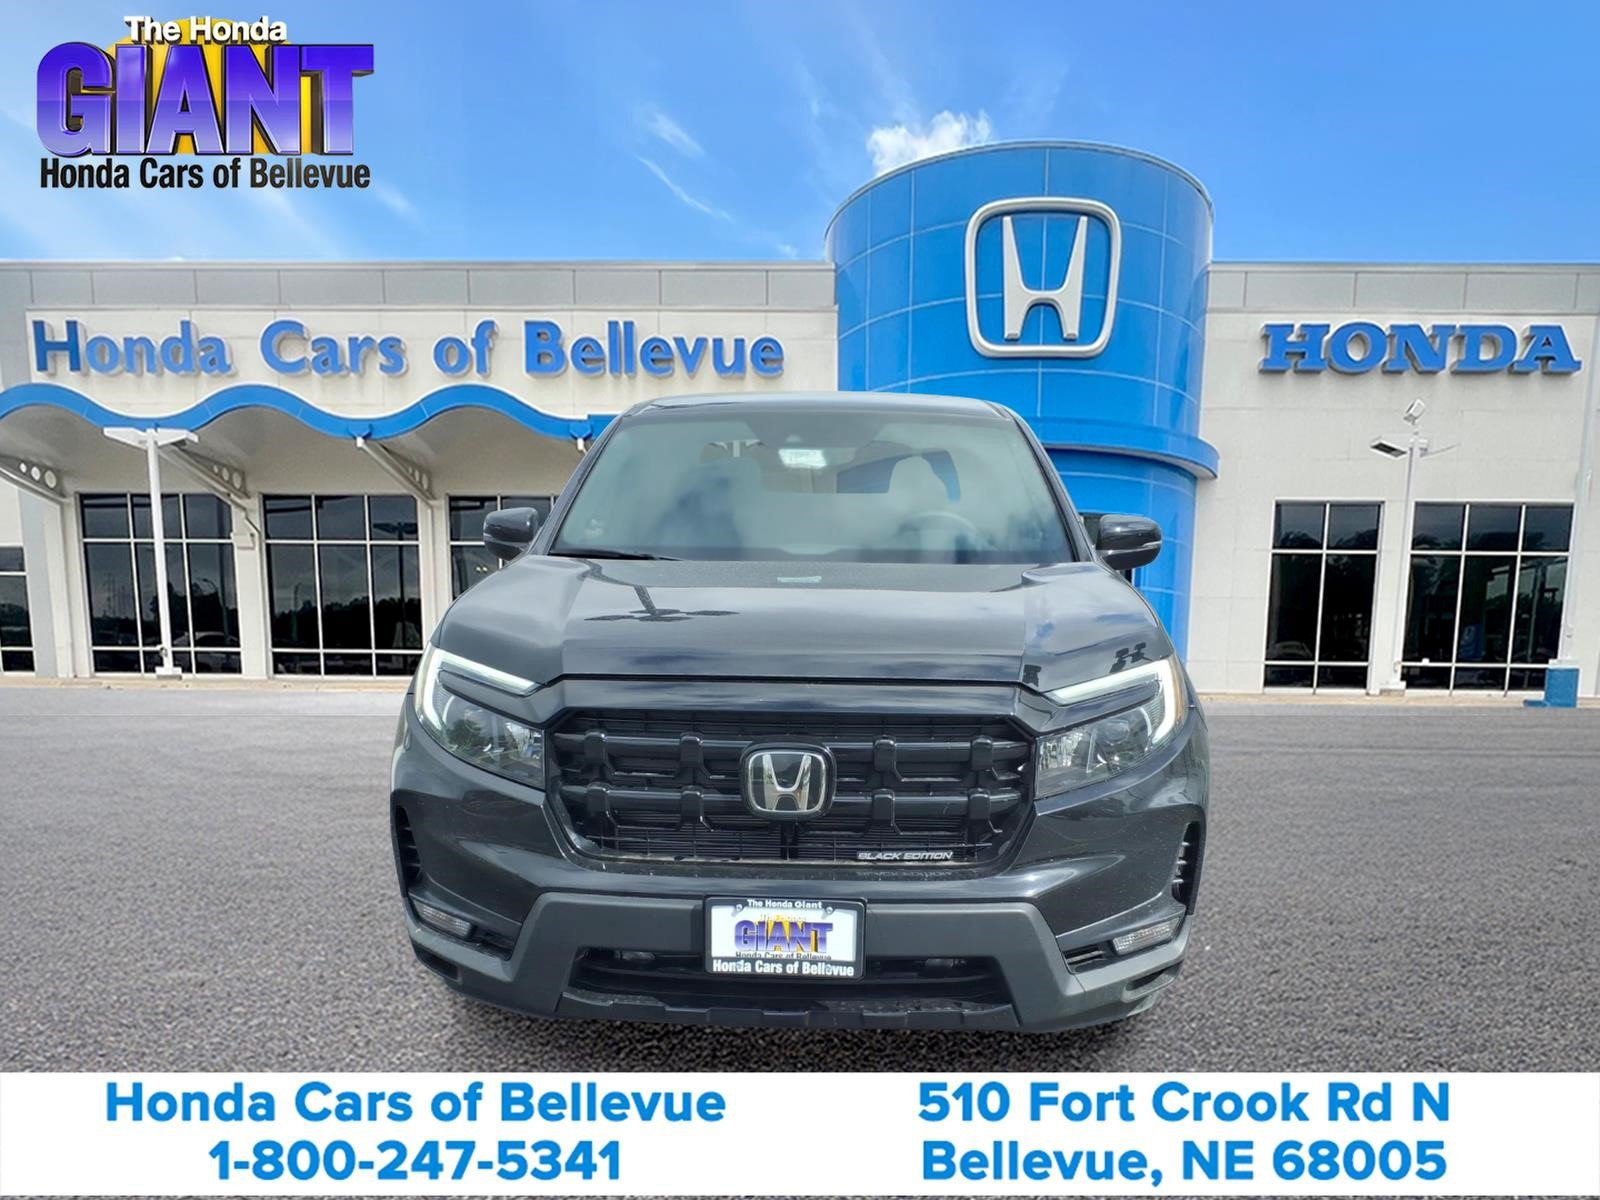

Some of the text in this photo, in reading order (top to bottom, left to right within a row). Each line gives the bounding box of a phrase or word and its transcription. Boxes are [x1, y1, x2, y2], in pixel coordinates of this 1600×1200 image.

[32, 319, 785, 377] Honda Cars of Bellevue
[1259, 321, 1582, 374] HONDA
[857, 851, 954, 861] BLACK EDITION
[747, 899, 823, 909] The Honda Giant
[734, 919, 833, 953] GIANT
[712, 959, 855, 977] Honda Cars of Bellevue
